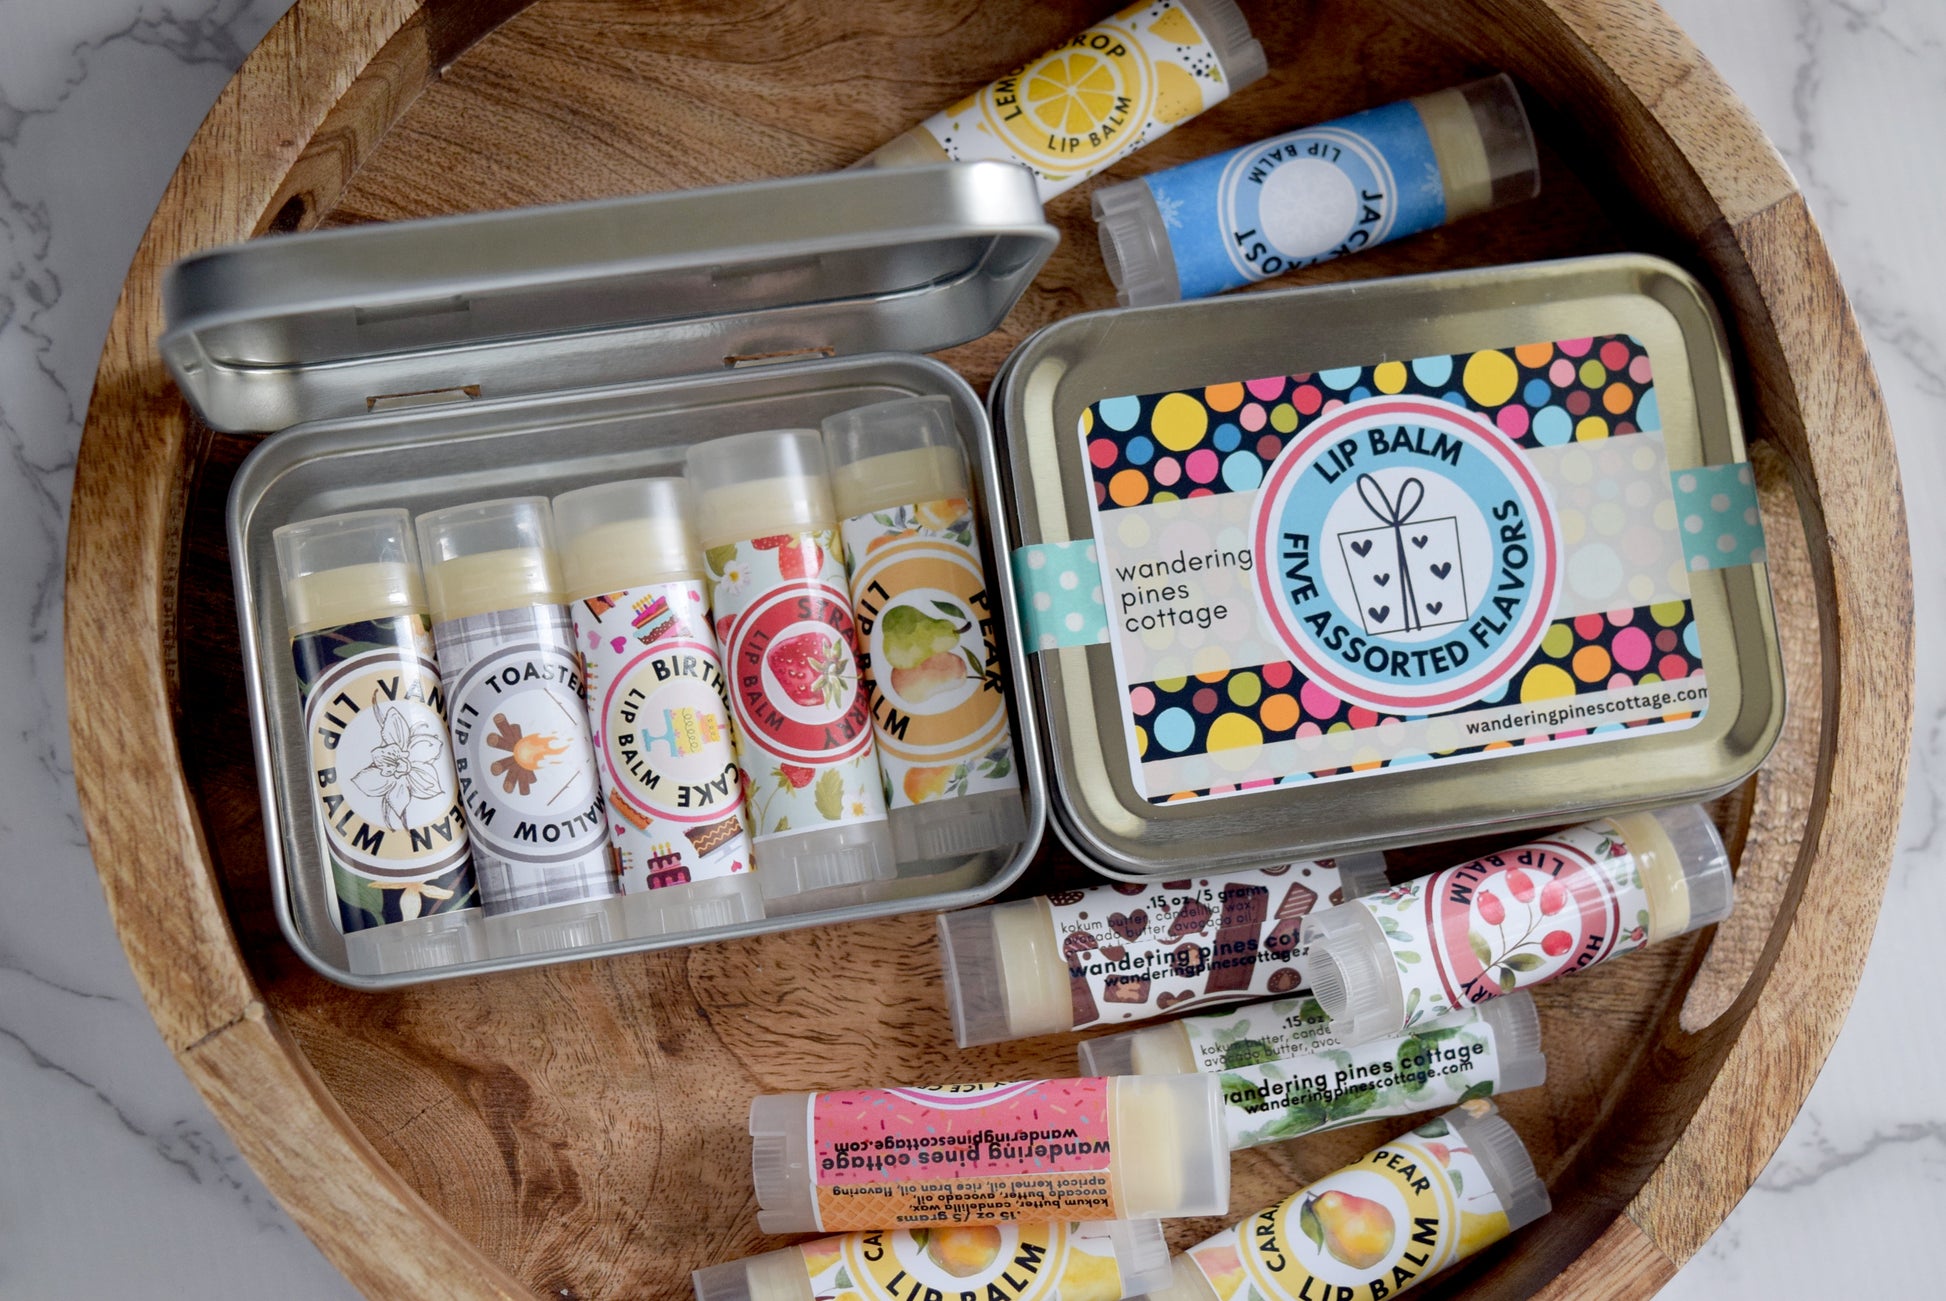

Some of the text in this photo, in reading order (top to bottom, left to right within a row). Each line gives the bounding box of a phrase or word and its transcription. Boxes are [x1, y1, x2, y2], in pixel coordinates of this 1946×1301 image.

[1048, 97, 1131, 153] LIP BALM
[1248, 143, 1341, 184] LIP BALM
[1313, 426, 1463, 484] LIP BALM
[1116, 549, 1253, 582] wandering
[858, 580, 890, 636] LIP
[1121, 584, 1190, 614] pines
[1283, 500, 1529, 677] FIVE ASSORTED FLAVORS
[1126, 604, 1228, 632] cottage
[969, 589, 1002, 694] PEAR
[743, 630, 785, 731] LIP BALM
[618, 688, 661, 790] LIP BALM
[317, 692, 385, 856] LIP BALM
[455, 702, 497, 826] LIP BALM
[677, 762, 739, 807] CAKE
[1450, 851, 1564, 905] LIP BALM
[1171, 896, 1190, 906] oz
[1061, 919, 1102, 934] kokum
[1069, 948, 1190, 978] wandering
[1199, 939, 1258, 966] pines
[1283, 1016, 1301, 1029] .15
[1205, 1050, 1259, 1067] avocado
[1265, 1042, 1307, 1057] butter,
[1224, 1075, 1327, 1105] andering
[1335, 1061, 1393, 1089] pines
[1401, 1043, 1483, 1069] cottage
[1245, 1061, 1473, 1114] wanderingpinescottage.com
[822, 1141, 1110, 1171] wandering pines cottage
[835, 1128, 1077, 1153] wanderingpinescottage.com
[833, 1176, 1106, 1197] apricot kernel oil, rice bran oil, flavoring
[1372, 1151, 1430, 1196] PEAR
[897, 1211, 947, 1223] grams
[909, 1198, 1108, 1213] kokum butter, candelilla wax,
[913, 1188, 1107, 1205] avocado butter, avocado oil,
[977, 1211, 995, 1219] oz
[1299, 1217, 1439, 1301] LIP BALM
